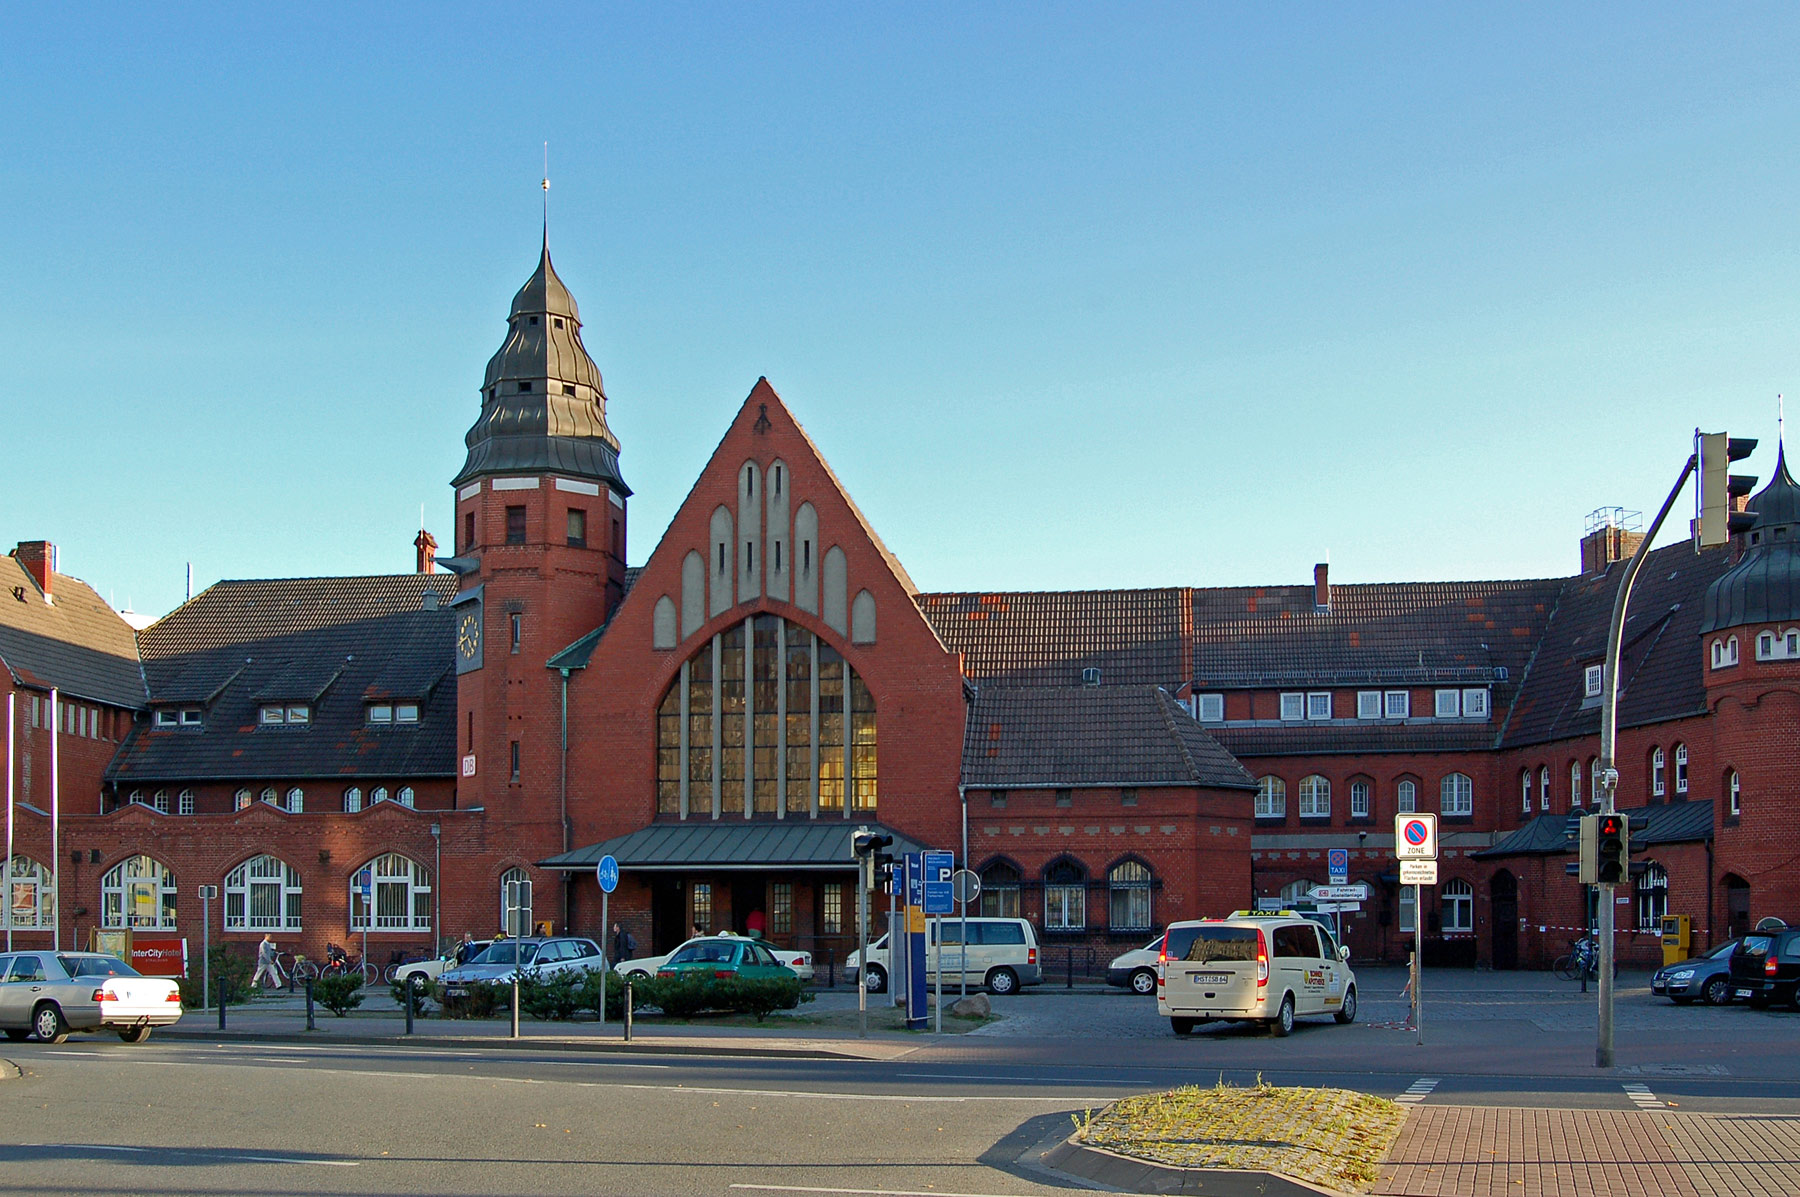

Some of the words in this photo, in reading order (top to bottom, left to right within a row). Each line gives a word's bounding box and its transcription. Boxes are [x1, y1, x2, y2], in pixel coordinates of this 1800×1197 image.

[465, 758, 475, 774] DB
[1407, 847, 1425, 855] ZONE
[939, 868, 951, 882] P
[131, 949, 181, 958] InterCityHotel
